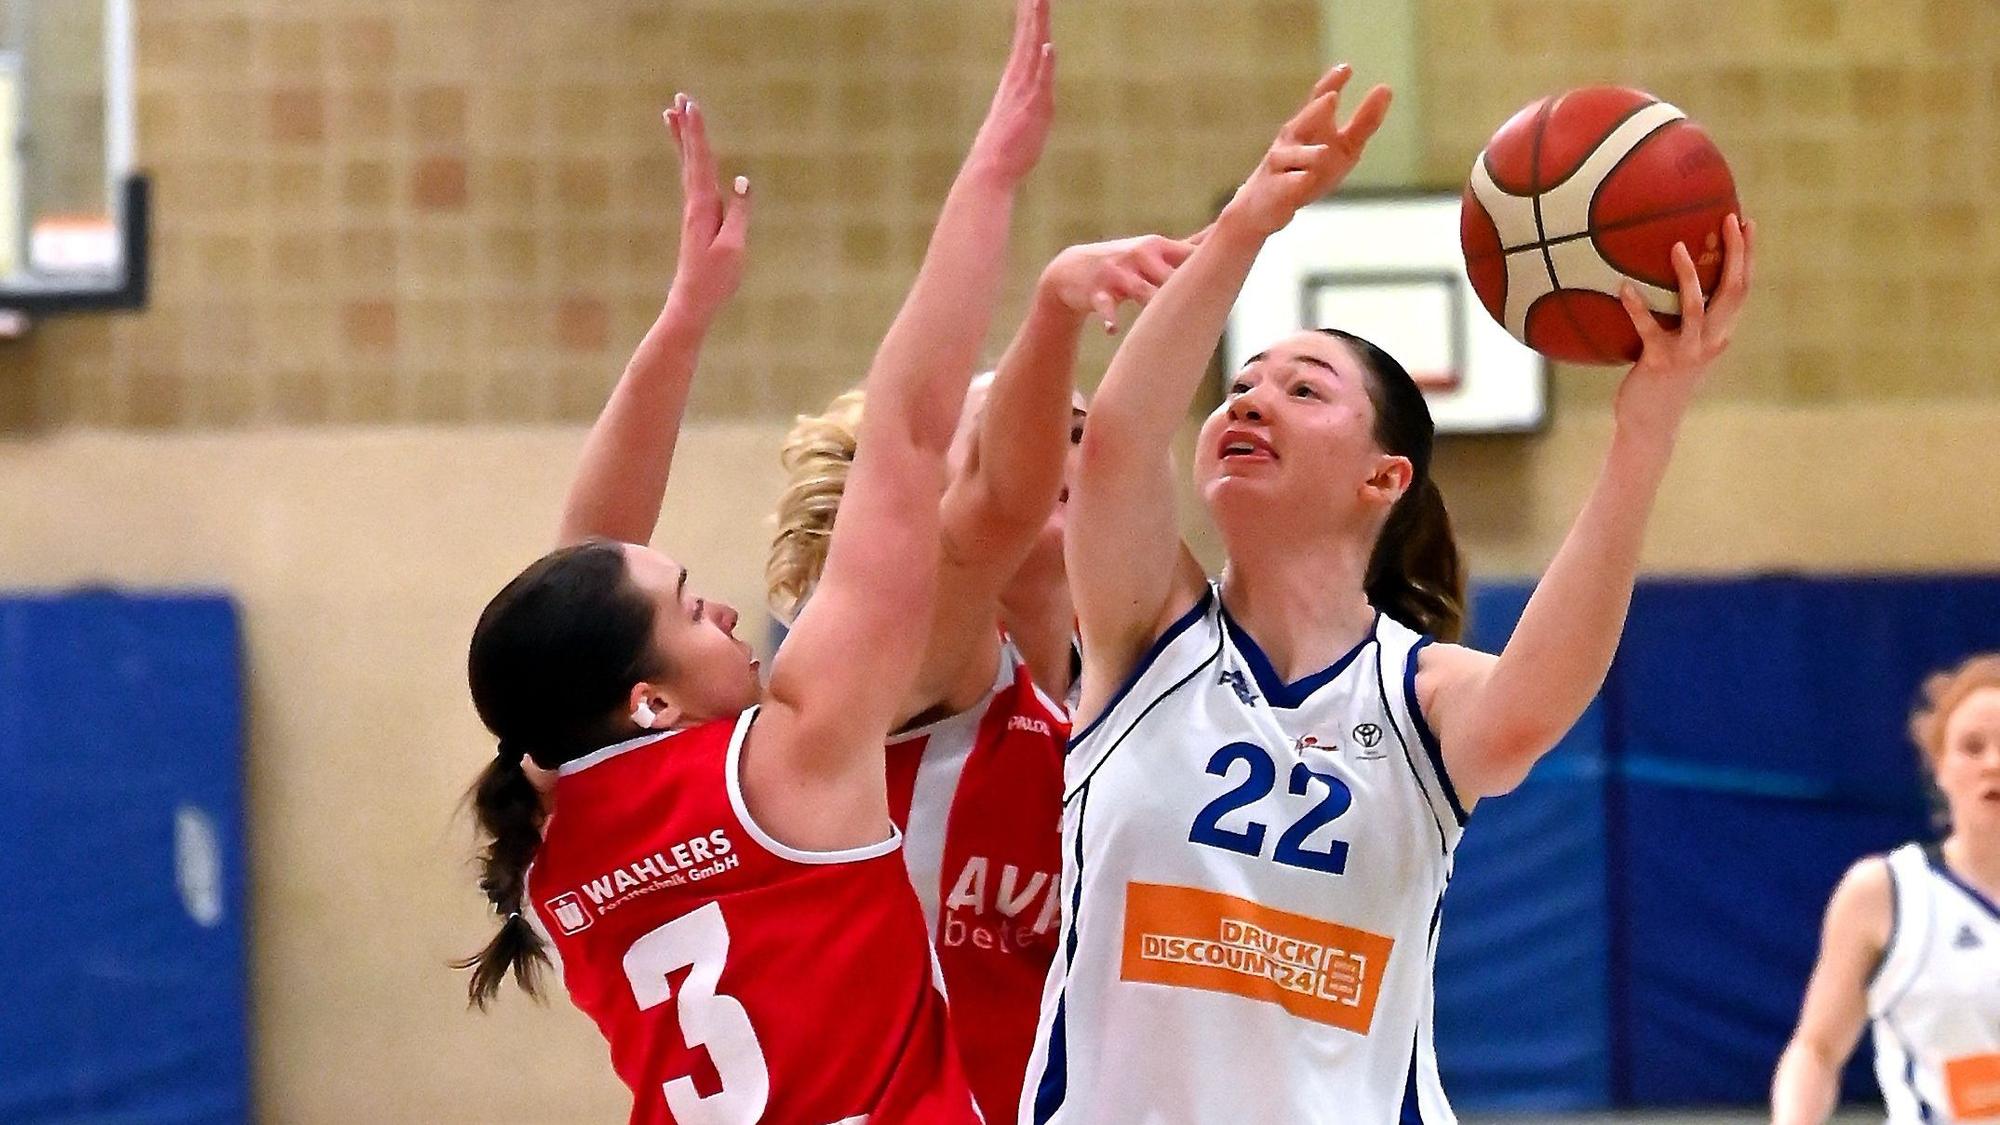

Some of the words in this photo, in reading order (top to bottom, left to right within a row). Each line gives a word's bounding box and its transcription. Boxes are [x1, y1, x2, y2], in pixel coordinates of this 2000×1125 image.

[1188, 741, 1352, 876] 22
[581, 829, 732, 905] WAHLERS
[688, 853, 740, 881] GmbH
[1142, 934, 1316, 995] DISCOUNT24
[1221, 919, 1322, 969] DRUCK
[623, 900, 770, 1125] 3
